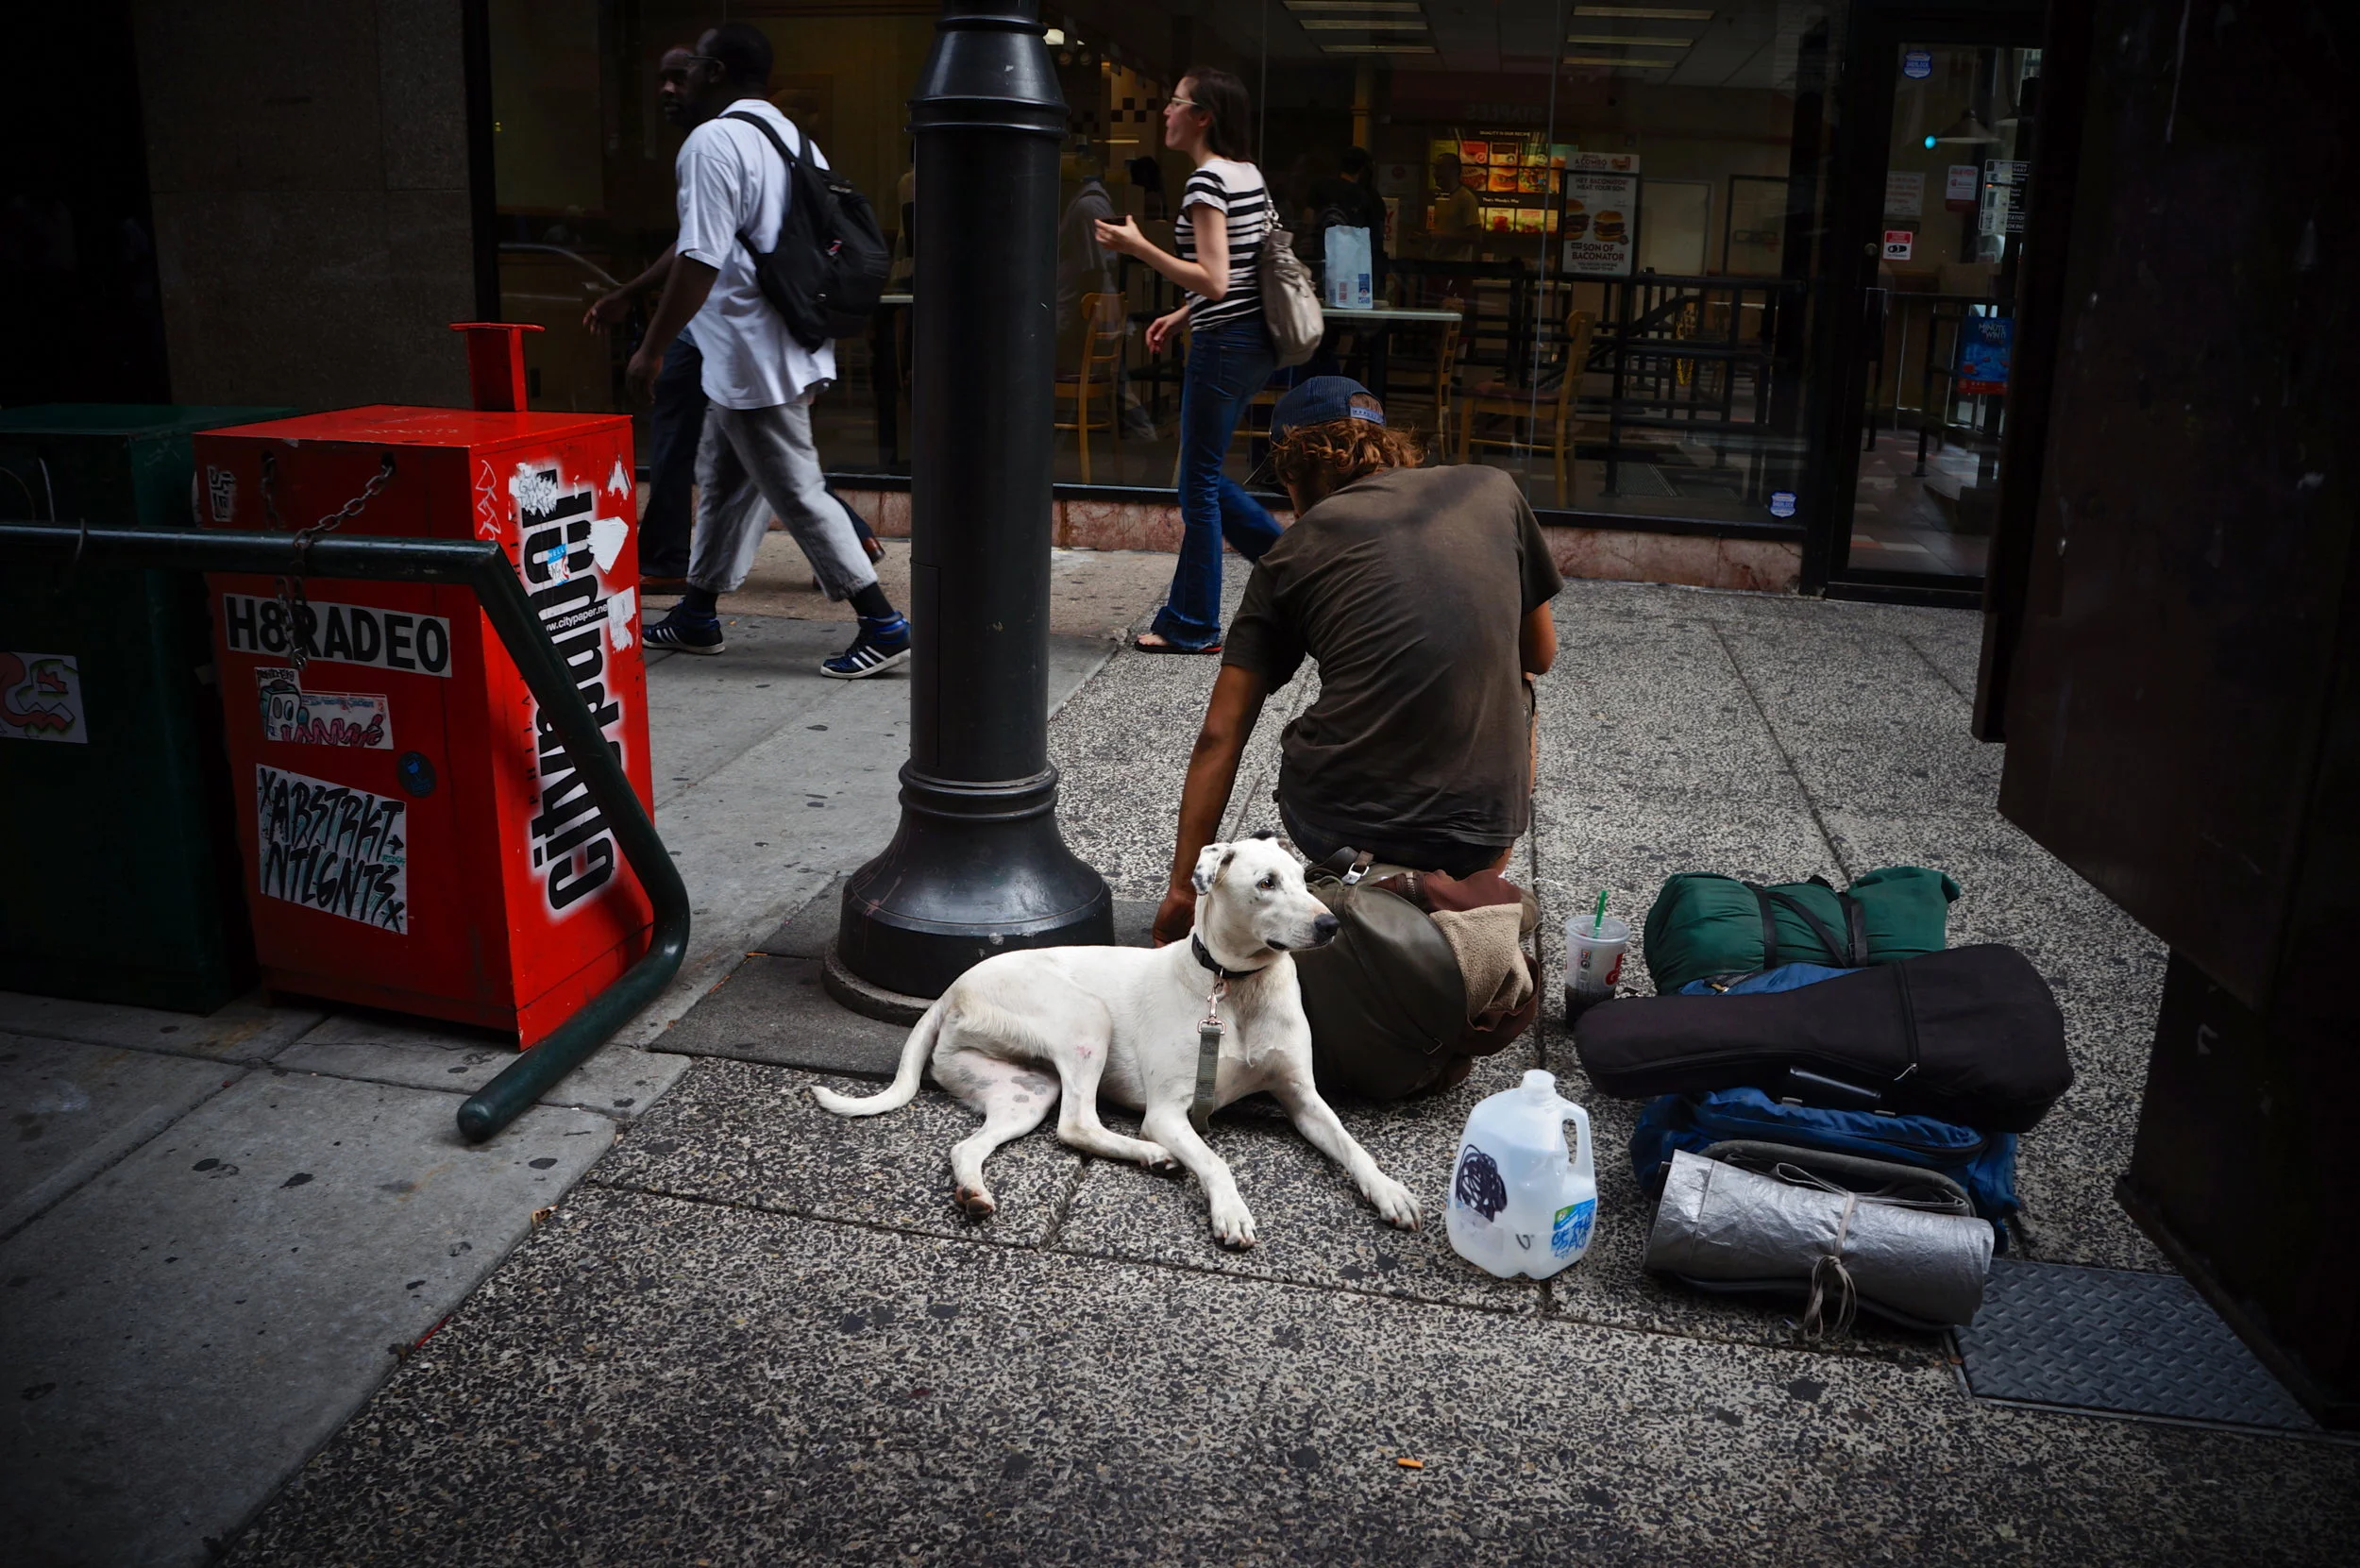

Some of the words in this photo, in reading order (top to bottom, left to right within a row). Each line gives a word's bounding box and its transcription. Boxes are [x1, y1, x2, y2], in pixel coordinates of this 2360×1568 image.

[1583, 243, 1602, 251] SON
[1603, 244, 1615, 252] OF
[1572, 252, 1624, 261] BACONATOR
[546, 603, 608, 632] w.citypaper.ne
